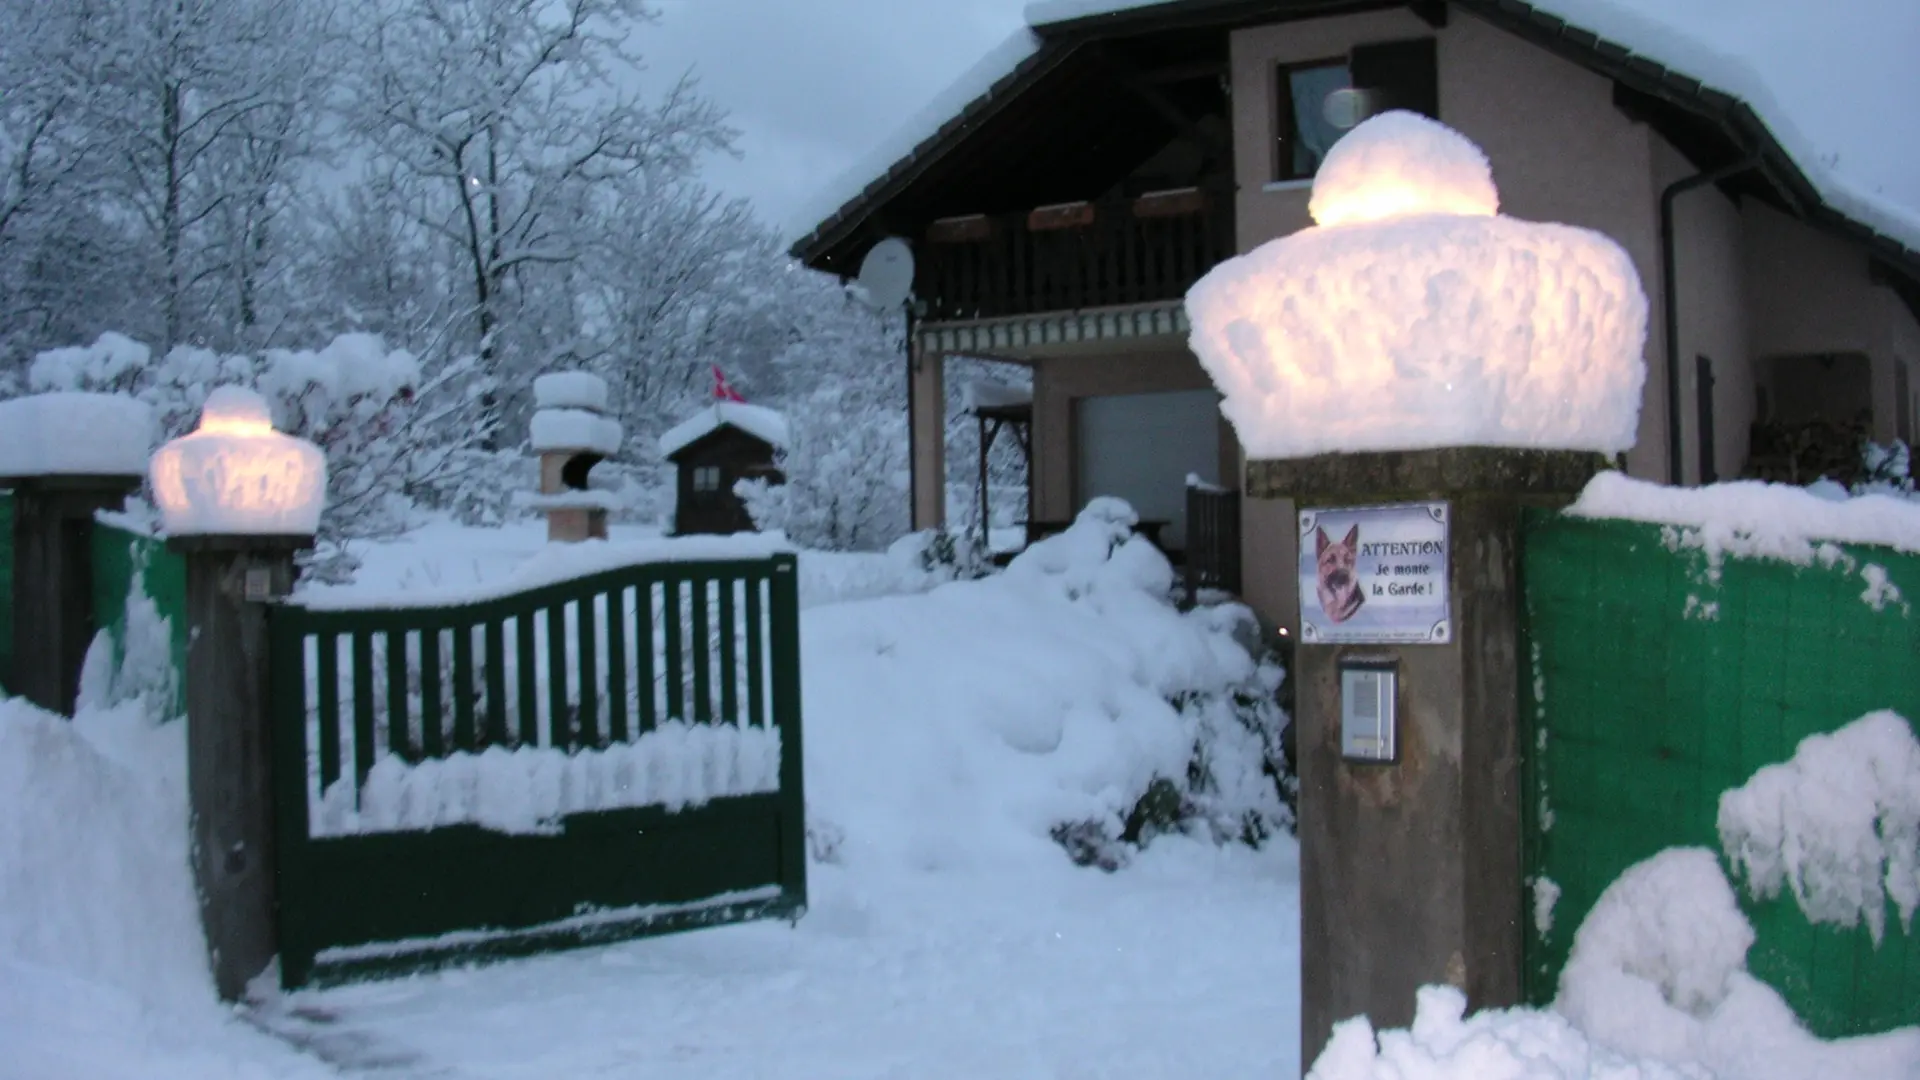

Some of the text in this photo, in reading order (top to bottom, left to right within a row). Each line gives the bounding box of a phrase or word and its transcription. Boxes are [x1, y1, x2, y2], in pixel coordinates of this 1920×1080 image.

[1361, 541, 1443, 557] ATTENTION
[1375, 563, 1430, 576] Je monte
[1372, 583, 1384, 596] la
[1388, 582, 1424, 595] Garde
